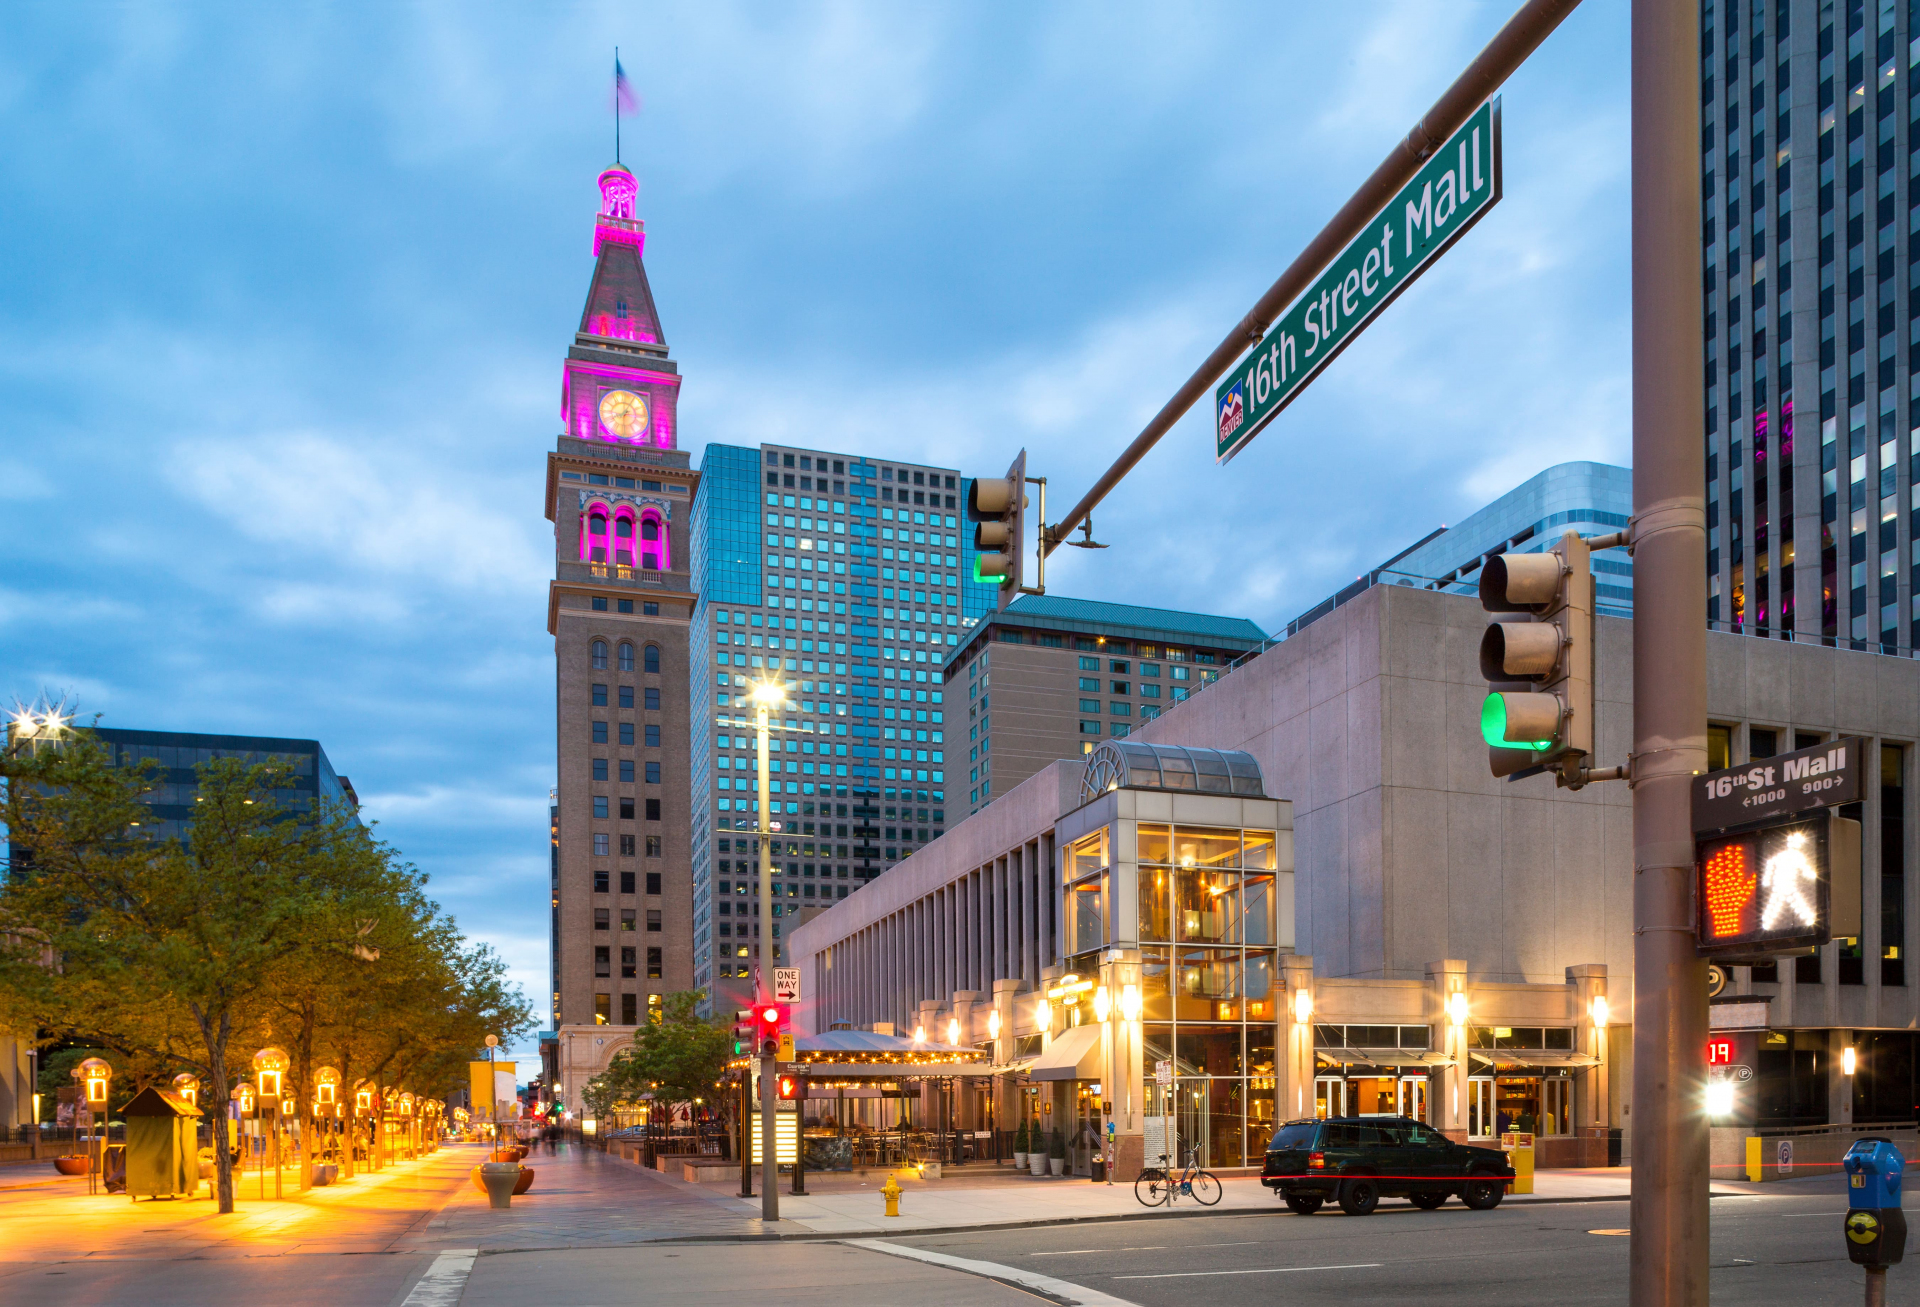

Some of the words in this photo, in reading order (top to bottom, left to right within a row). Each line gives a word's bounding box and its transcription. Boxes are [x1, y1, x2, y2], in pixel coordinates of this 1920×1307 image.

[1245, 331, 1296, 413] 16th
[1304, 222, 1394, 358] Street
[1406, 126, 1484, 258] Mall
[1219, 409, 1243, 444] DENVER
[1783, 747, 1846, 782] Mall
[1802, 778, 1832, 794] 900
[1752, 788, 1786, 806] 1000
[776, 980, 797, 989] WAY
[777, 971, 797, 980] ONE
